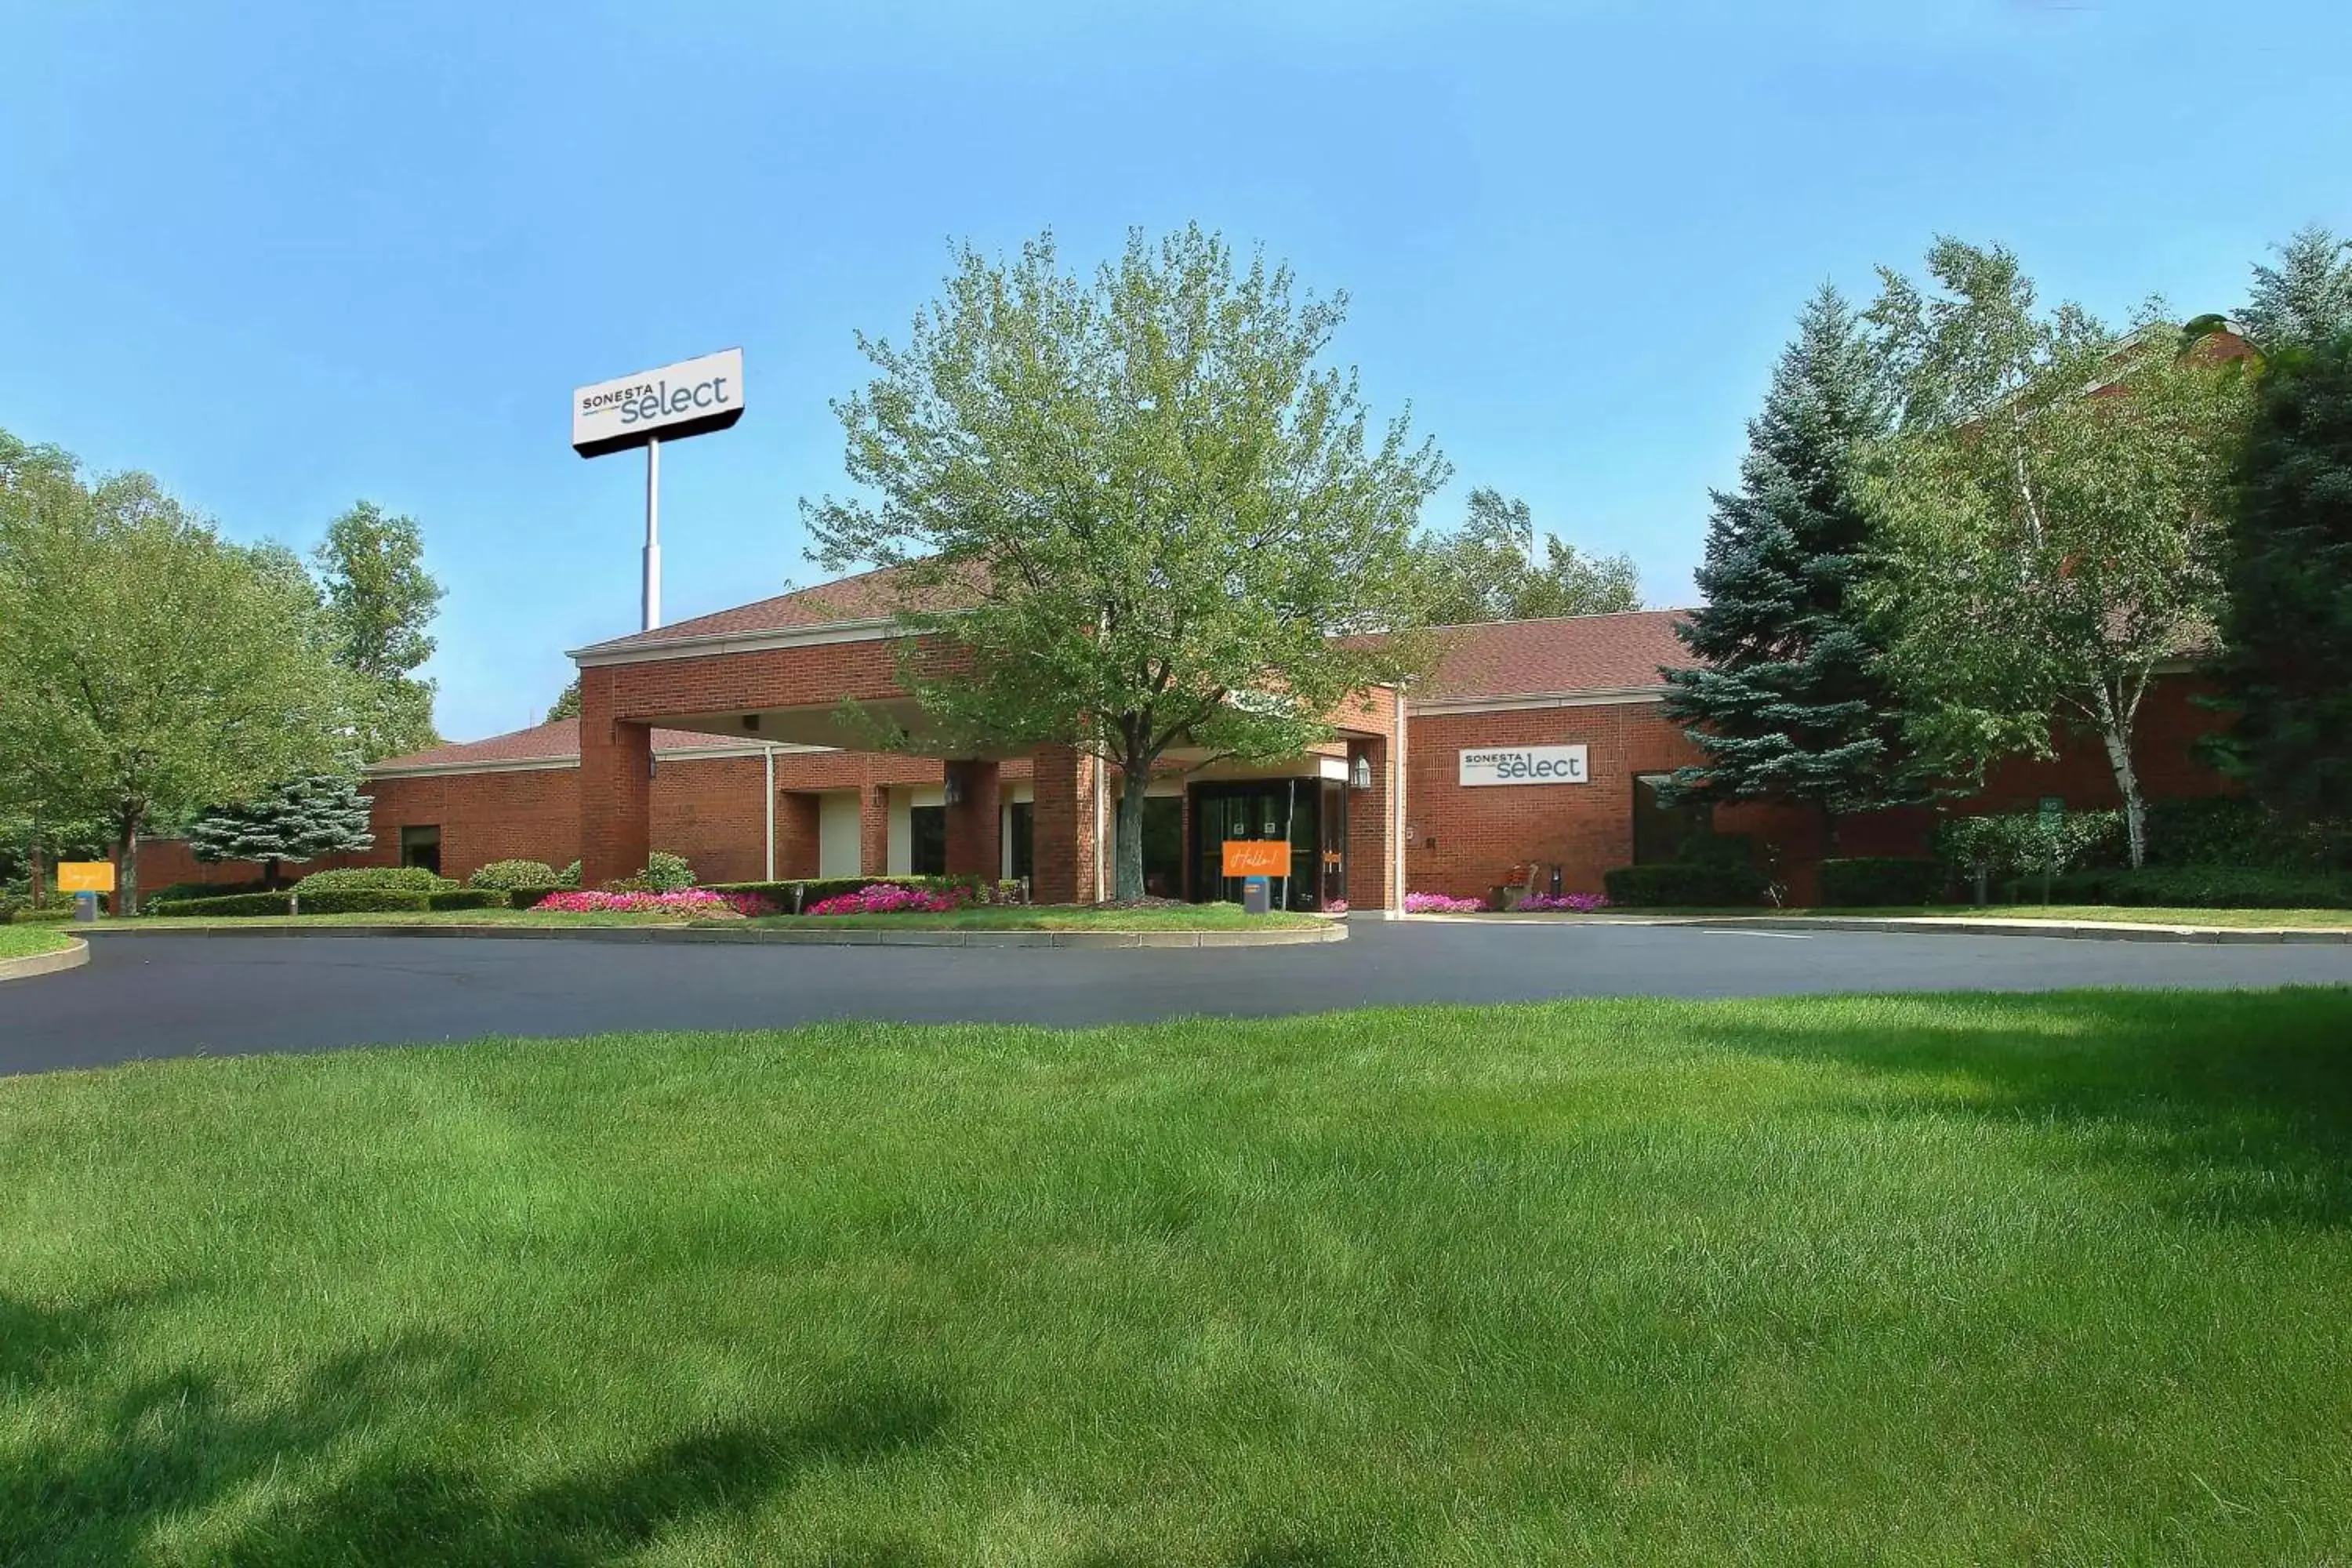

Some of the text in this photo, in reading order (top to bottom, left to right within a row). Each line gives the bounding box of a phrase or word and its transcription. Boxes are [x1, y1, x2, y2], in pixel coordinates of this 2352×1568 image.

[583, 383, 653, 409] SONESTA
[621, 377, 729, 423] select
[1465, 753, 1523, 763] SONESTA
[1497, 753, 1581, 779] select
